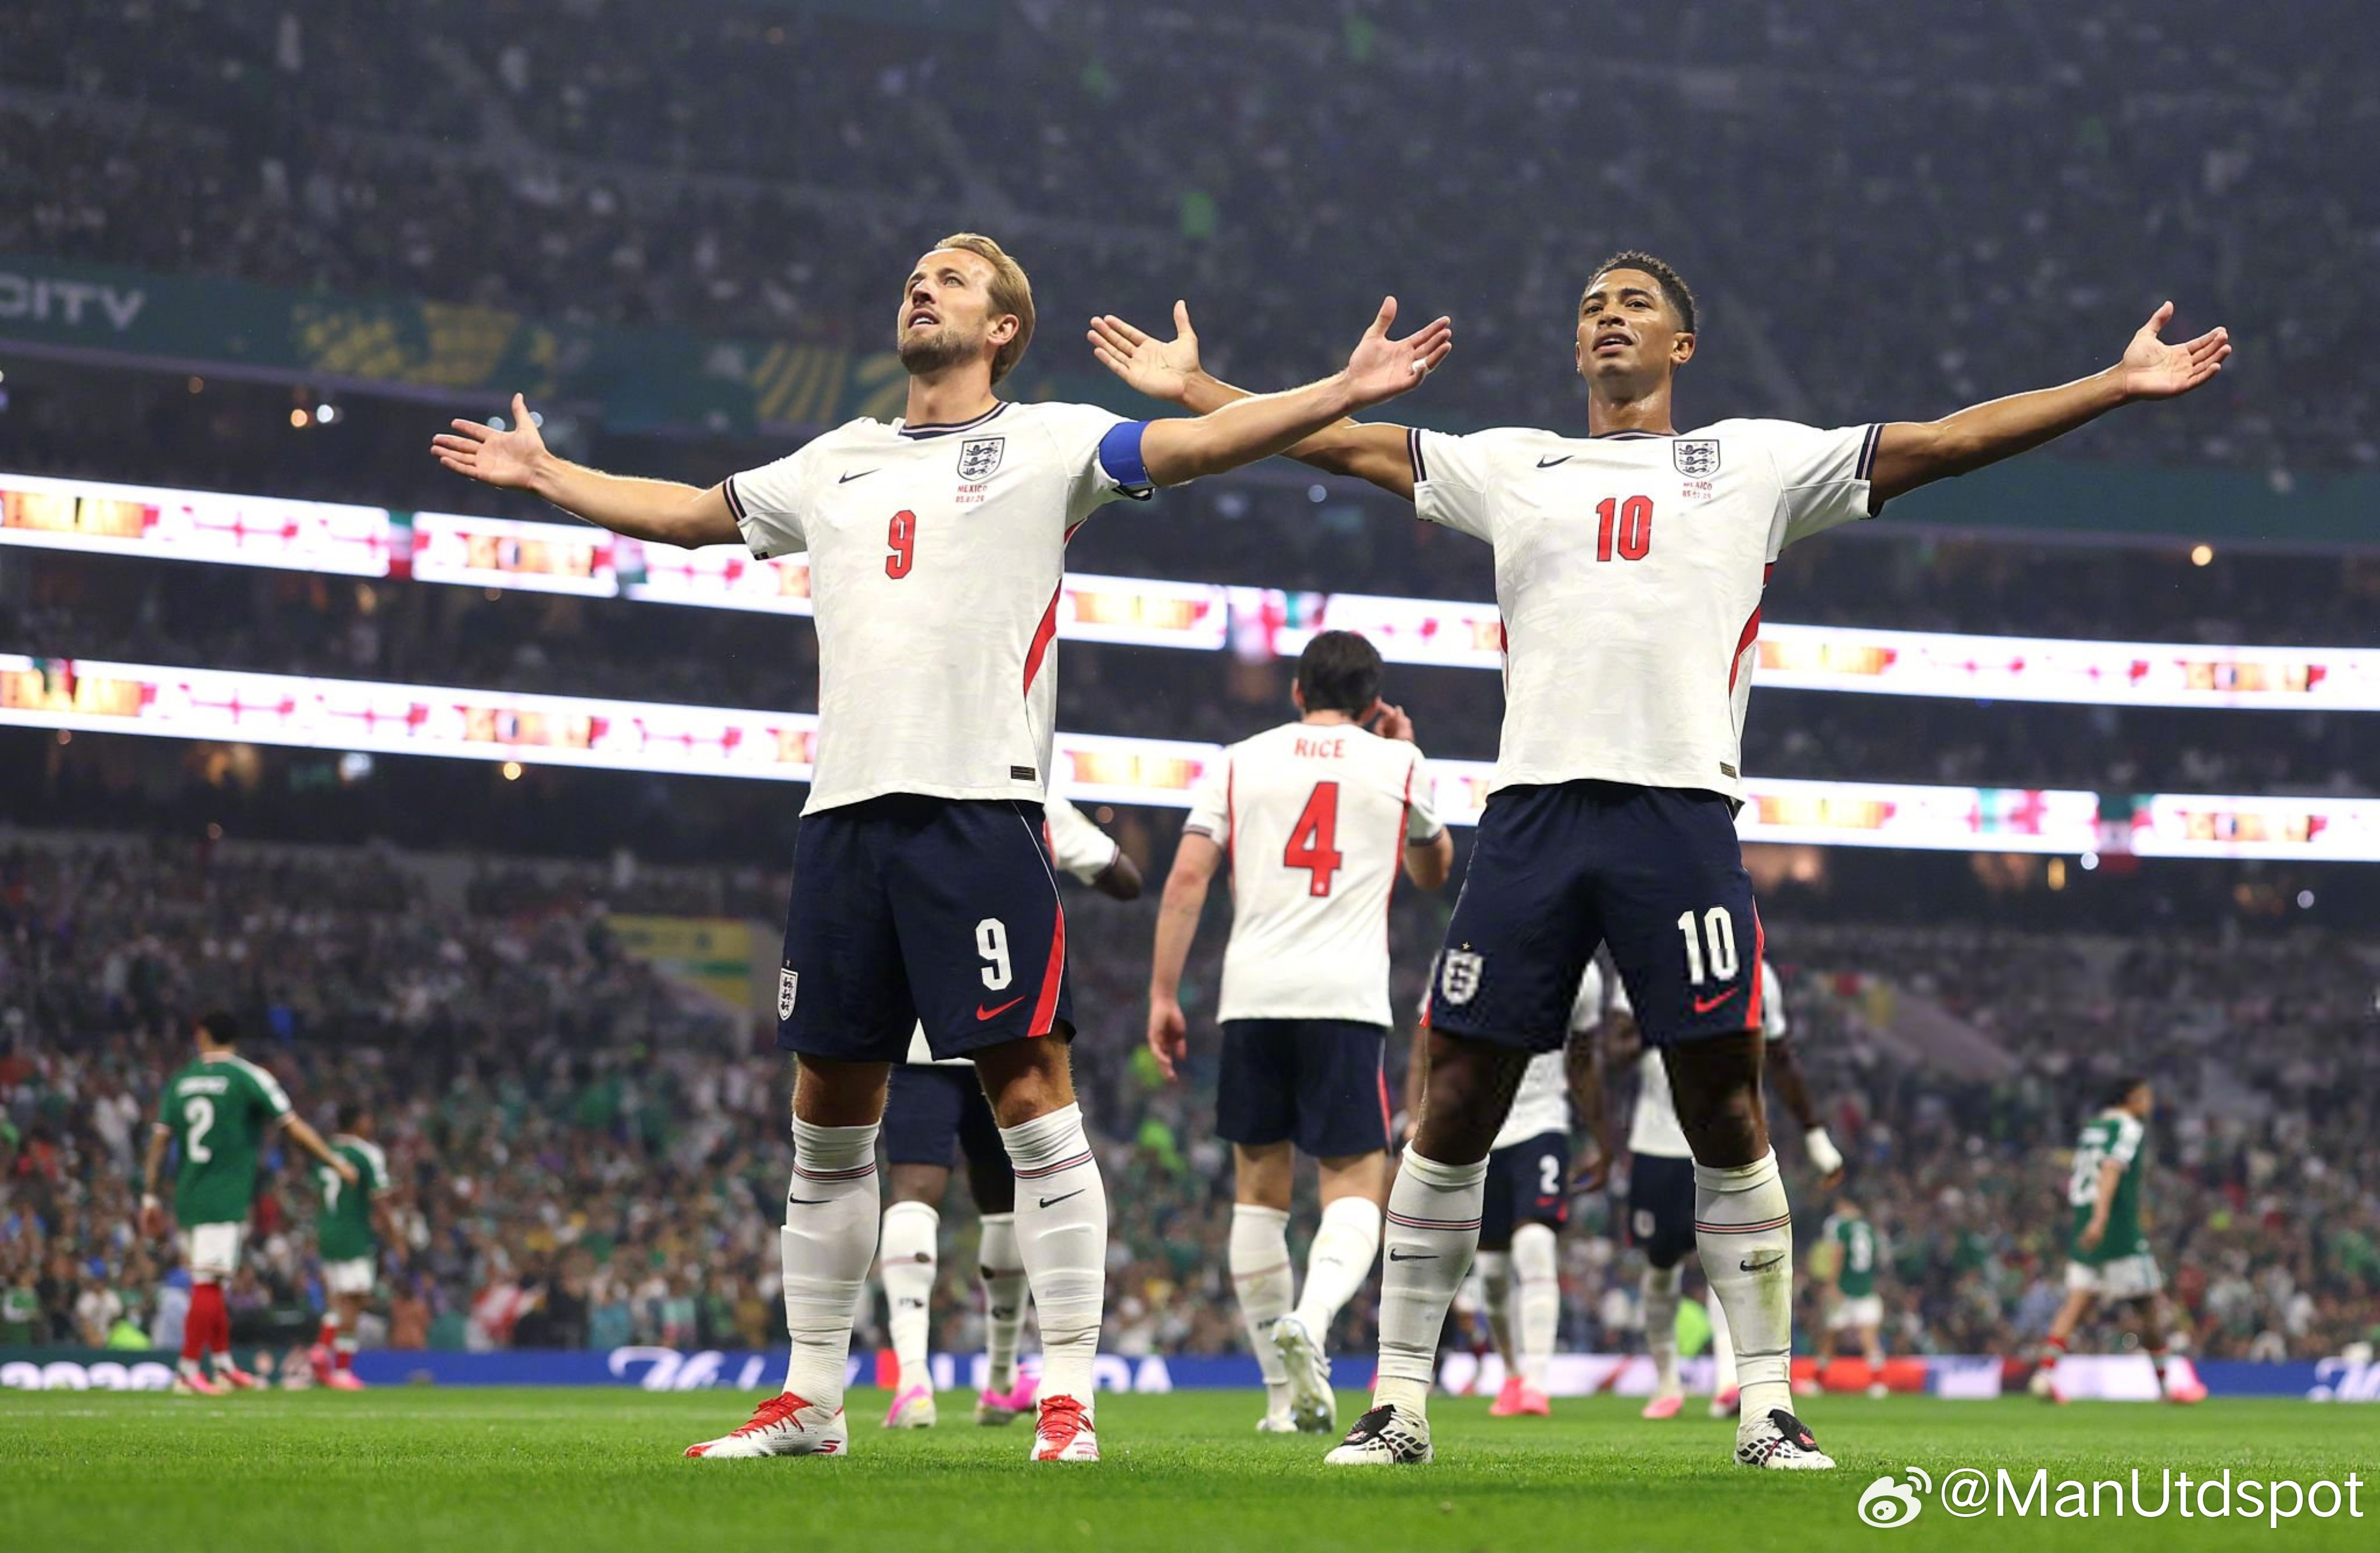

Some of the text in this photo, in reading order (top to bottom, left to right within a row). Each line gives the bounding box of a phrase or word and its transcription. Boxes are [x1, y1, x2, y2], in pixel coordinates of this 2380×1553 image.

[957, 484, 988, 493] MEXICO
[885, 509, 916, 580] 9
[1595, 495, 1654, 562] 10
[1294, 738, 1346, 758] RICE
[1284, 781, 1342, 897] 4
[975, 917, 1013, 991] 9
[1678, 906, 1739, 984] 10
[183, 1095, 215, 1163] 2
[1539, 1154, 1560, 1194] 2
